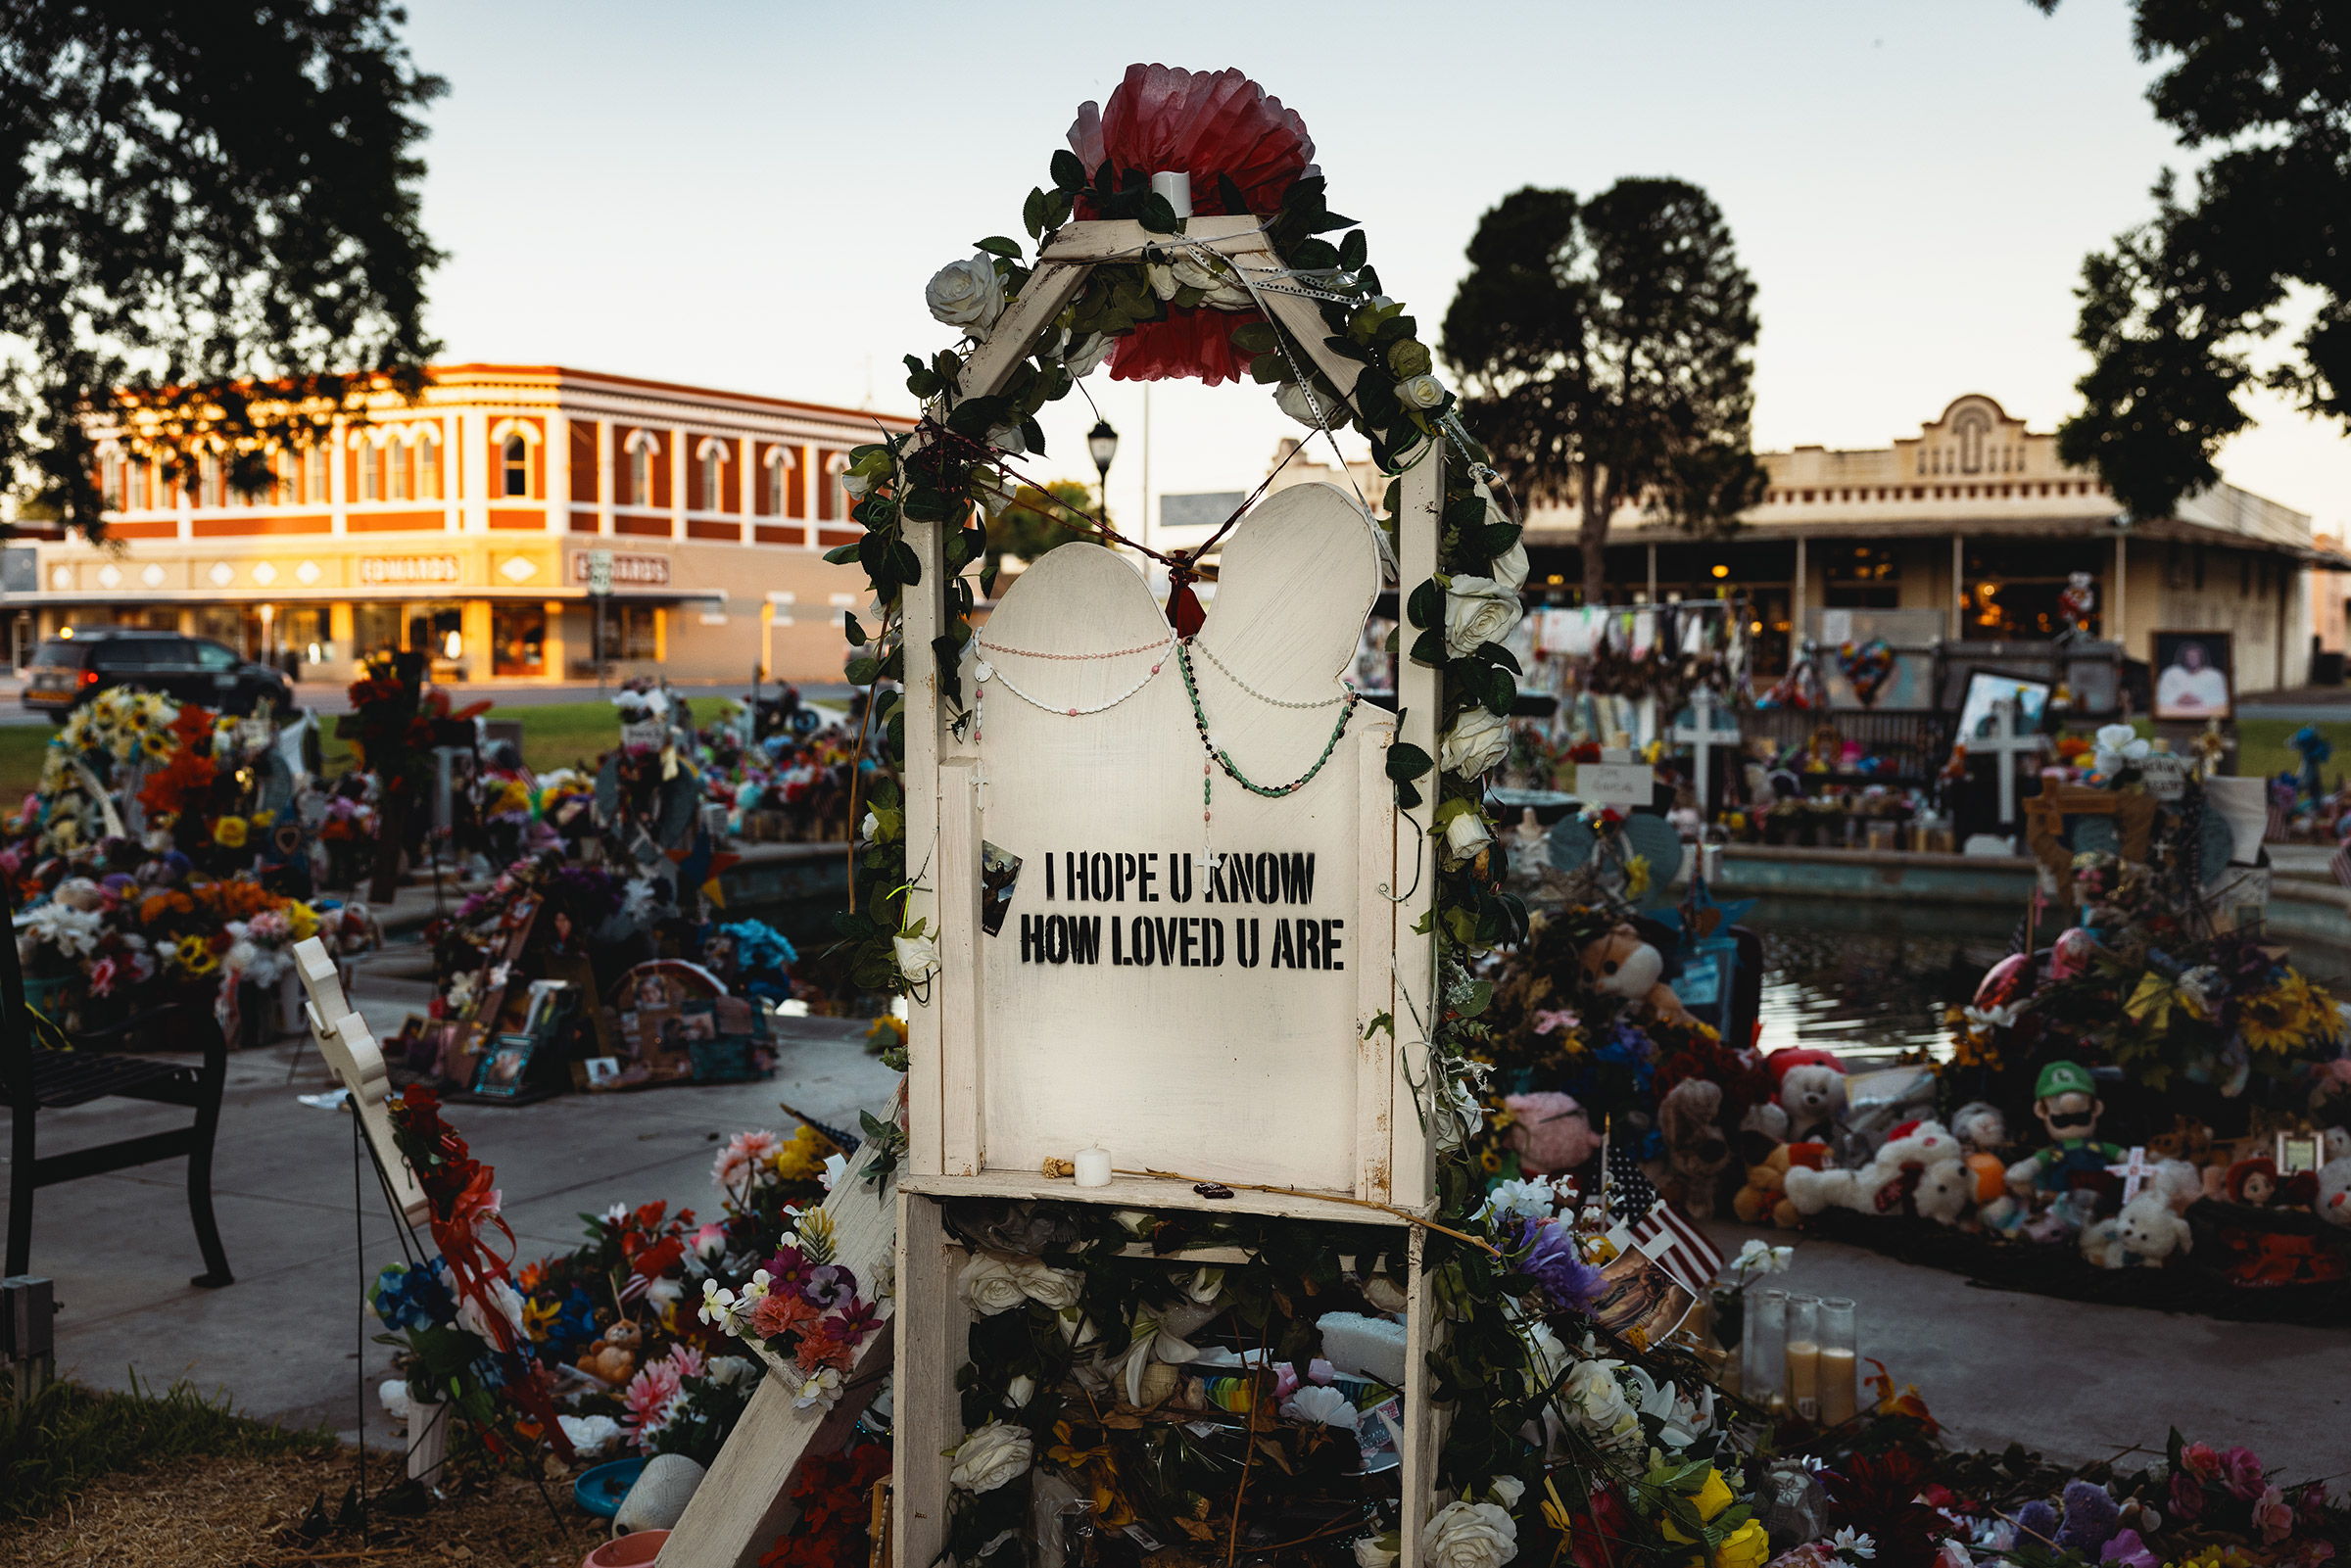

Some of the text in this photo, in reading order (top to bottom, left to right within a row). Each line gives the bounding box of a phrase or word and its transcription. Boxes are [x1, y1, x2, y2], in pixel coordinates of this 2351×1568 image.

[361, 558, 458, 580] EDWARDS
[578, 557, 667, 582] EARDS
[1045, 850, 1316, 904] I HOPE U KNOW
[1021, 914, 1344, 970] HOW LOVED U ARE
